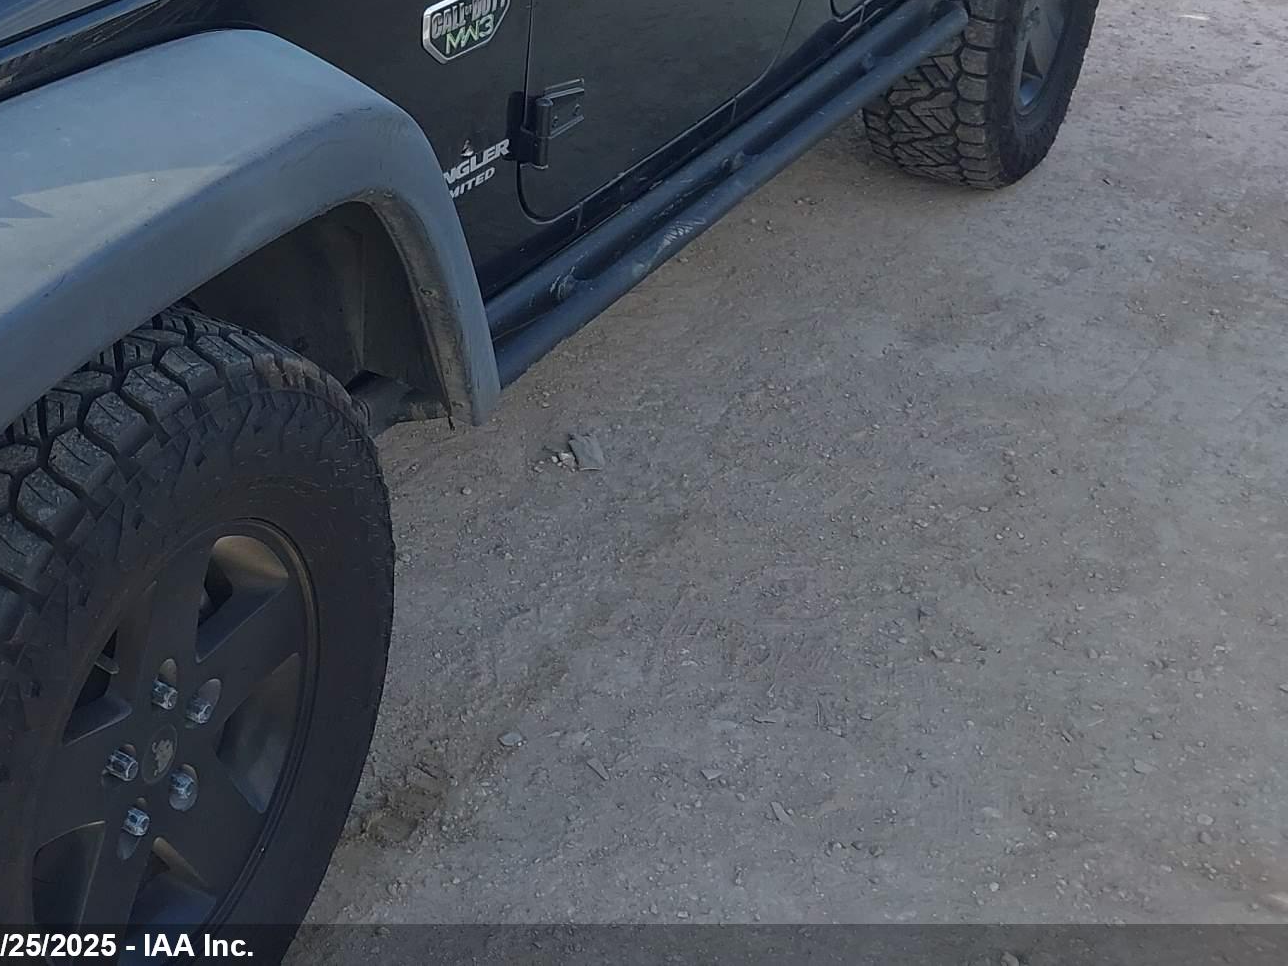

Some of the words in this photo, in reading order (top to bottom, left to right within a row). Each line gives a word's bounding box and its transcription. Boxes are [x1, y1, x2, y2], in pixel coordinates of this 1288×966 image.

[432, 3, 466, 39] CALL
[446, 14, 494, 54] MW3
[443, 138, 509, 184] NGLER
[450, 166, 495, 199] MITED
